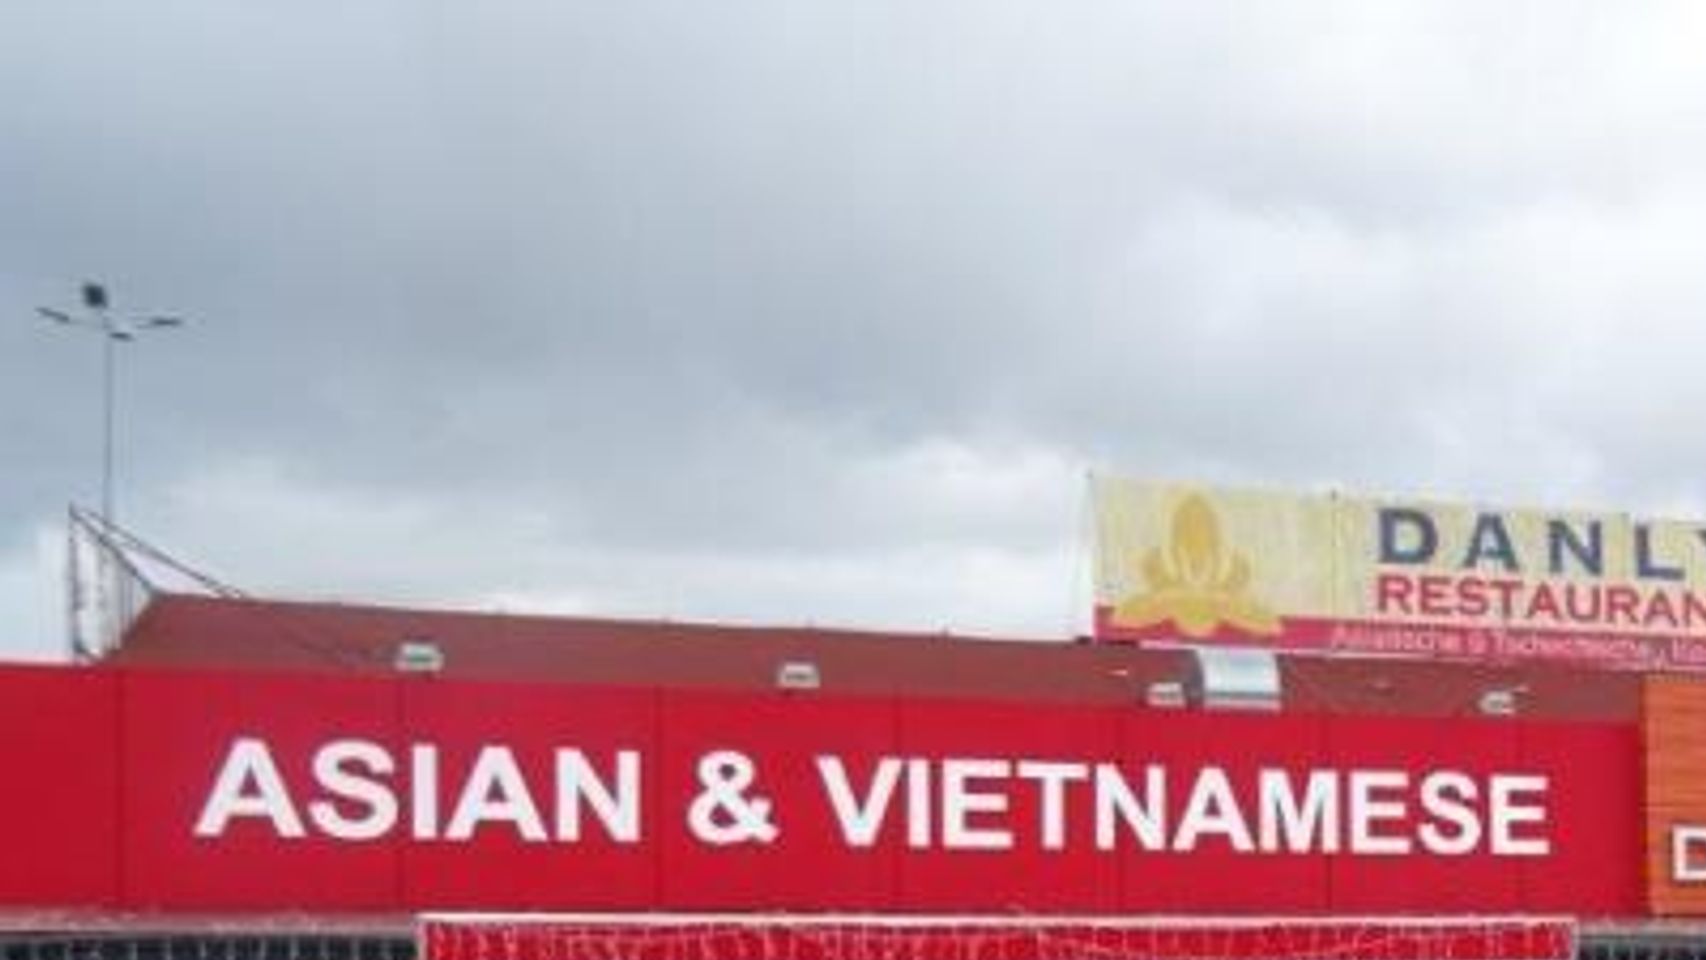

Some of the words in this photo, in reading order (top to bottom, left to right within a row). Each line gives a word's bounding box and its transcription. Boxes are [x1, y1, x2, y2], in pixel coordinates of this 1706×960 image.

[195, 737, 641, 843] ASIAN
[687, 749, 778, 846] &
[816, 755, 1550, 856] VIETNAMESE
